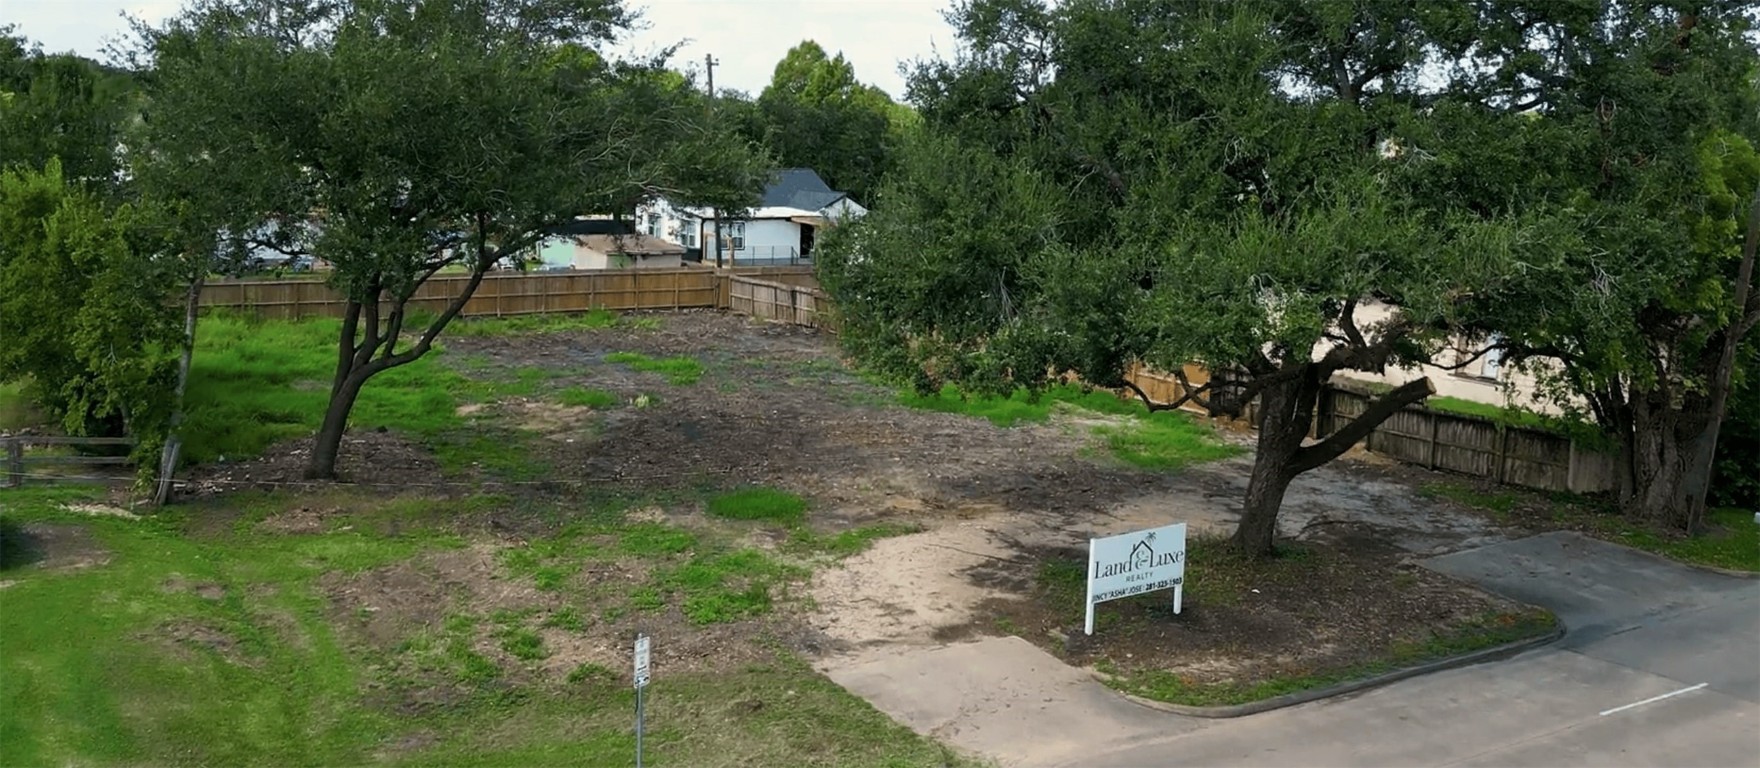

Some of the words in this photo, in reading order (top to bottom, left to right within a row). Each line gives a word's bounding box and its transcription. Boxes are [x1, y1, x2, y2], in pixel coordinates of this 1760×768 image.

[1095, 556, 1132, 579] Land
[1135, 550, 1149, 569] &
[1149, 550, 1184, 568] Luxe
[1125, 571, 1154, 582] REALTY
